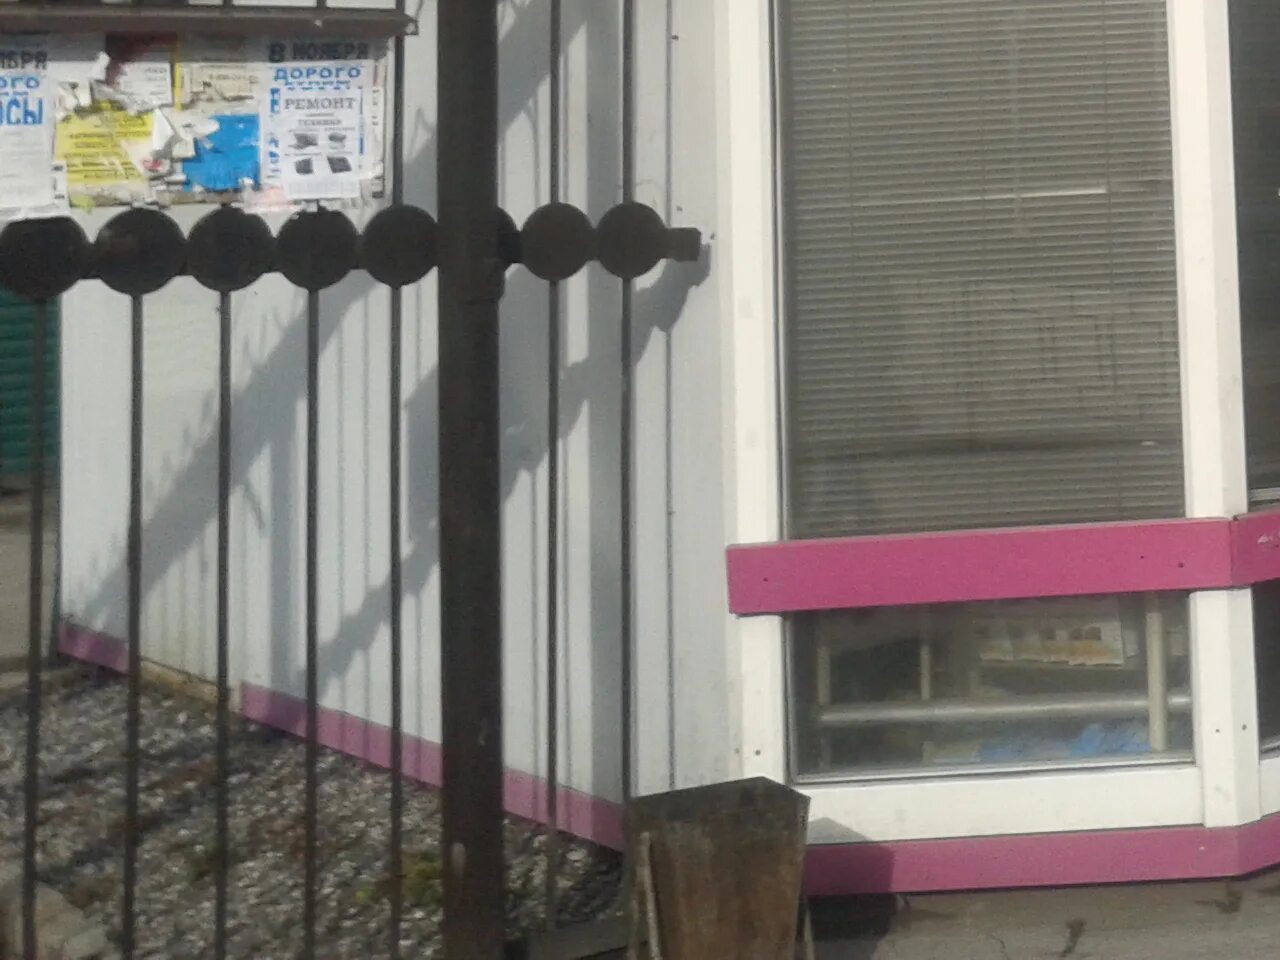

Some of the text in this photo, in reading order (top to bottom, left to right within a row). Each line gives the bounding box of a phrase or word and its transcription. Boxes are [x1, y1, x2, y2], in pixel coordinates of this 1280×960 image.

[274, 66, 362, 81] ДОРОГО
[284, 96, 356, 111] РЕМОНТ
[0, 98, 43, 125] СЫ
